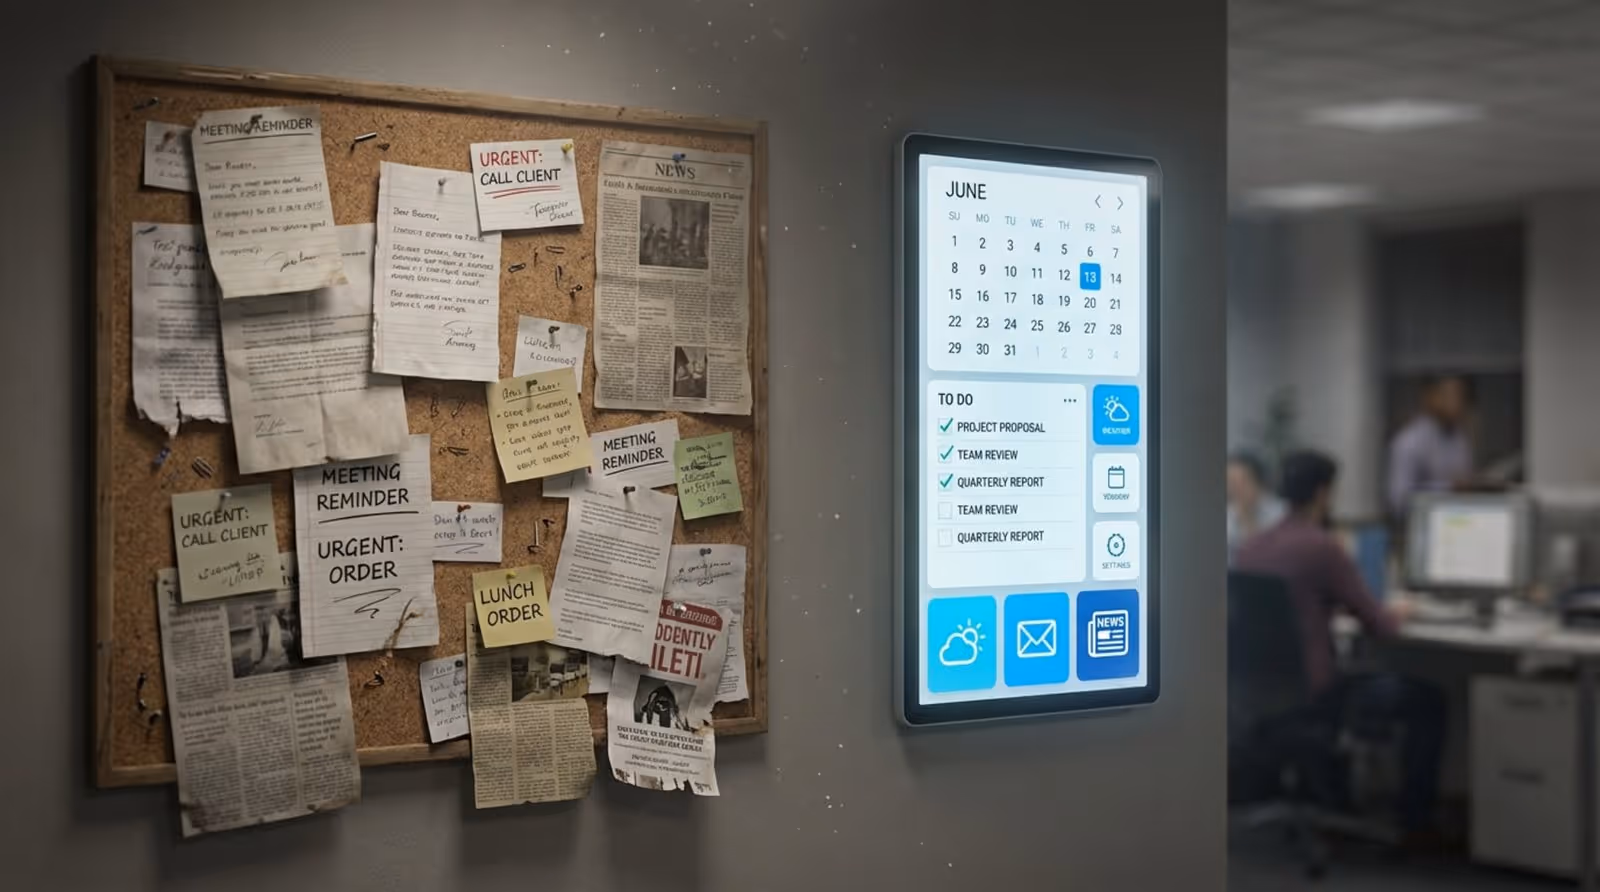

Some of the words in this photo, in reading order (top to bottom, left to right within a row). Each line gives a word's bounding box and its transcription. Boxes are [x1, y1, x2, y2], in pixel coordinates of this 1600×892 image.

[200, 122, 251, 136] MEETING
[480, 150, 543, 167] URGENT:
[480, 171, 512, 186] CALL
[516, 168, 561, 184] CLIENT
[655, 163, 696, 180] NEWS
[946, 180, 987, 200] JUNE
[948, 211, 961, 220] SU
[975, 213, 990, 223] MO
[1004, 216, 1017, 226] TU
[1030, 219, 1044, 228] WE
[1058, 221, 1070, 229] TH
[1084, 223, 1096, 232] FR
[1110, 225, 1123, 234] SA
[951, 235, 957, 246] 1
[979, 237, 987, 249] 2
[1006, 239, 1014, 251] 3
[1033, 242, 1041, 252] 4
[1060, 244, 1069, 255] 5
[1086, 246, 1094, 257] 6
[1112, 248, 1119, 258] 7
[951, 262, 959, 273] 8
[979, 264, 987, 275] 9
[1004, 266, 1018, 277] 10
[1031, 268, 1043, 278] 11
[1058, 269, 1071, 281] 12
[1084, 272, 1097, 283] 13
[1110, 273, 1122, 284] 14
[948, 289, 962, 300] 15
[976, 290, 990, 302] 16
[1004, 292, 1017, 303] 17
[1031, 294, 1044, 305] 18
[1058, 296, 1071, 306] 19
[1083, 297, 1097, 308] 20
[1109, 299, 1121, 309] 21
[948, 315, 962, 327] 22
[975, 317, 990, 328] 23
[1003, 318, 1017, 329] 24
[1030, 320, 1044, 331] 25
[1057, 321, 1071, 332] 26
[1083, 322, 1097, 334] 27
[1109, 324, 1122, 335] 28
[948, 342, 962, 353] 29
[976, 343, 990, 355] 30
[1003, 344, 1016, 356] 31
[1035, 346, 1040, 358] 1
[1060, 347, 1068, 359] 2
[1087, 348, 1094, 359] 3
[938, 393, 954, 406] TO
[957, 393, 974, 406] DO
[958, 422, 997, 433] PROJECT
[1000, 422, 1046, 433] PROPOSAL
[604, 430, 656, 452] MEETING
[602, 447, 664, 470] REMINDER
[958, 449, 983, 460] TEAM
[985, 450, 1018, 460] REVIEW
[322, 463, 400, 485] MEETING
[957, 477, 1008, 489] QUARTERLY
[1010, 476, 1044, 488] REPORT
[317, 488, 409, 511] REMINDER
[958, 504, 983, 515] TEAM
[985, 504, 1018, 514] REVIEW
[180, 506, 249, 529] URGENT:
[182, 532, 217, 548] CALL
[220, 524, 268, 542] CLIENT
[957, 532, 1008, 544] QUARTERLY
[1010, 530, 1044, 542] REPORT
[318, 535, 404, 559] URGENT:
[329, 561, 398, 584] ORDER
[480, 581, 534, 604] LUNCH
[488, 603, 544, 626] ORDER
[1097, 616, 1124, 628] NEWS
